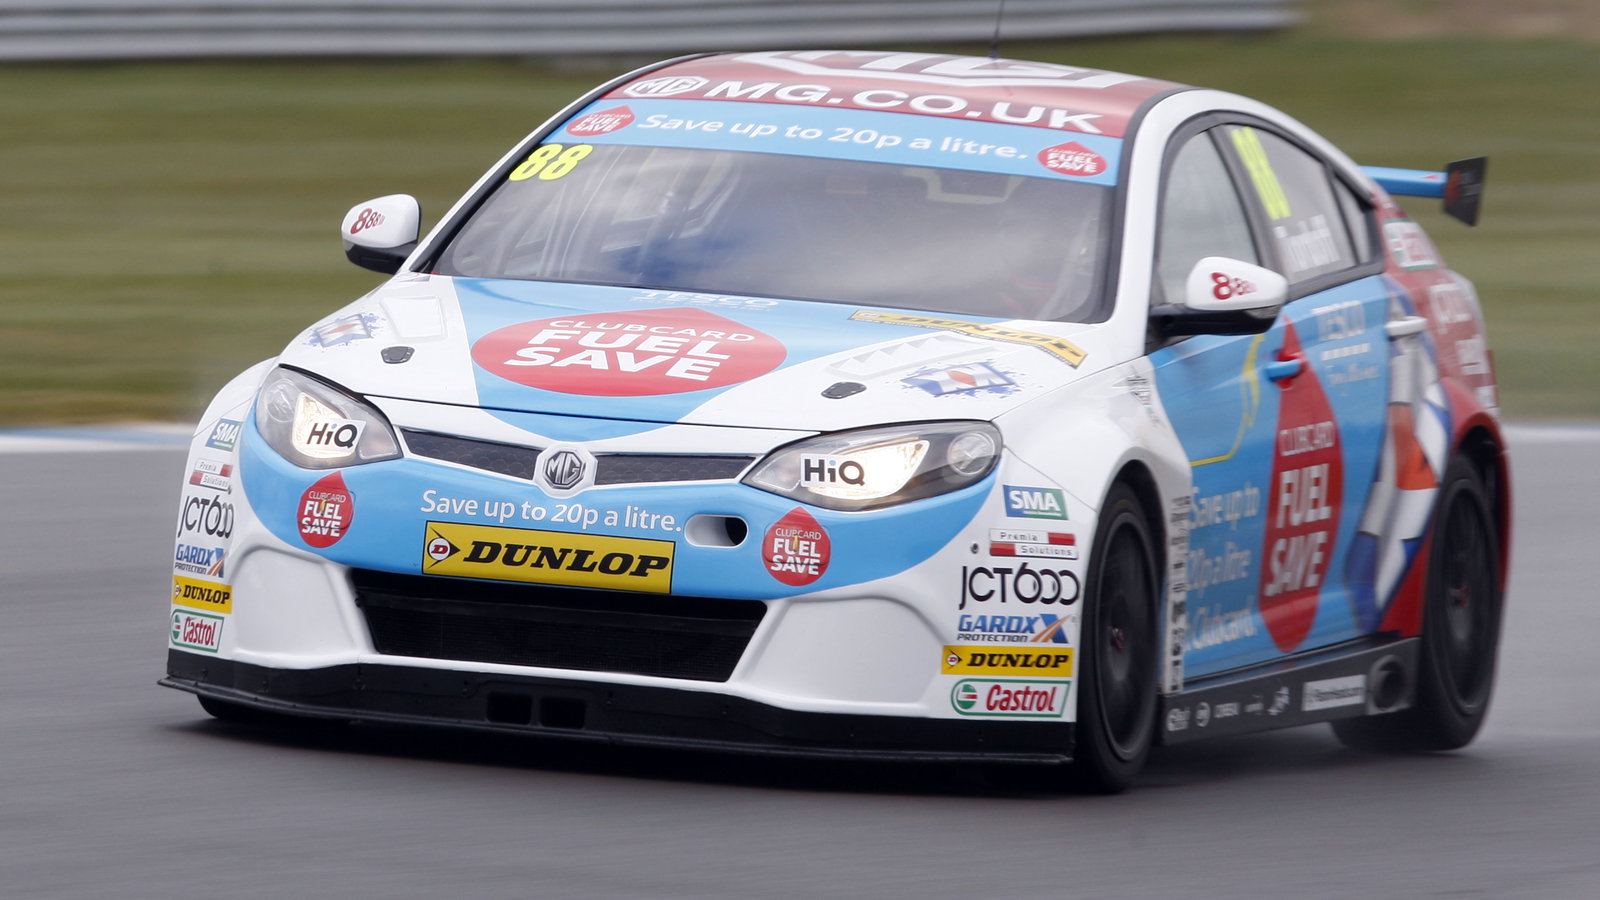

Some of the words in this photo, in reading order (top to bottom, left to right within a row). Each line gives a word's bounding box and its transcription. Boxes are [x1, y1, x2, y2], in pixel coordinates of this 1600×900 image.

[704, 80, 1104, 134] MG.CO.UK
[572, 123, 616, 132] SAVE
[578, 117, 622, 126] FUEL
[637, 114, 724, 132] Save
[729, 122, 778, 138] up
[784, 125, 824, 139] to
[827, 127, 903, 149] 20p
[908, 137, 932, 150] a
[940, 136, 1028, 159] litre.
[509, 143, 593, 181] 88
[1045, 160, 1097, 173] SAVE
[1047, 152, 1094, 164] FUEL
[549, 320, 756, 342] CLUBCARD
[527, 328, 731, 360] FUEL
[503, 347, 723, 381] SAVE
[211, 422, 240, 444] SMA
[306, 422, 358, 449] HiQ
[547, 452, 583, 485] MG
[804, 458, 865, 486] HiQ
[1008, 490, 1062, 511] SMA
[1276, 463, 1331, 529] FUEL
[303, 500, 342, 520] FUEL
[420, 489, 479, 517] Save
[484, 501, 516, 524] up
[521, 501, 547, 522] to
[550, 503, 599, 530] 20p
[604, 509, 619, 527] a
[624, 505, 682, 532] litre.
[301, 517, 341, 537] SAVE
[1000, 531, 1038, 542] Premia
[463, 541, 670, 577] DUNLOP
[773, 538, 821, 558] FUEL
[1021, 545, 1073, 556] Solutions
[174, 561, 208, 575] PROTECTION
[770, 555, 821, 575] SAVE
[183, 584, 231, 605] DUNLOP
[958, 562, 1081, 611] JCT600
[183, 616, 217, 647] Castrol
[956, 633, 1028, 643] PROTECTION
[967, 653, 1070, 668] DUNLOP
[985, 684, 1058, 711] Castrol
